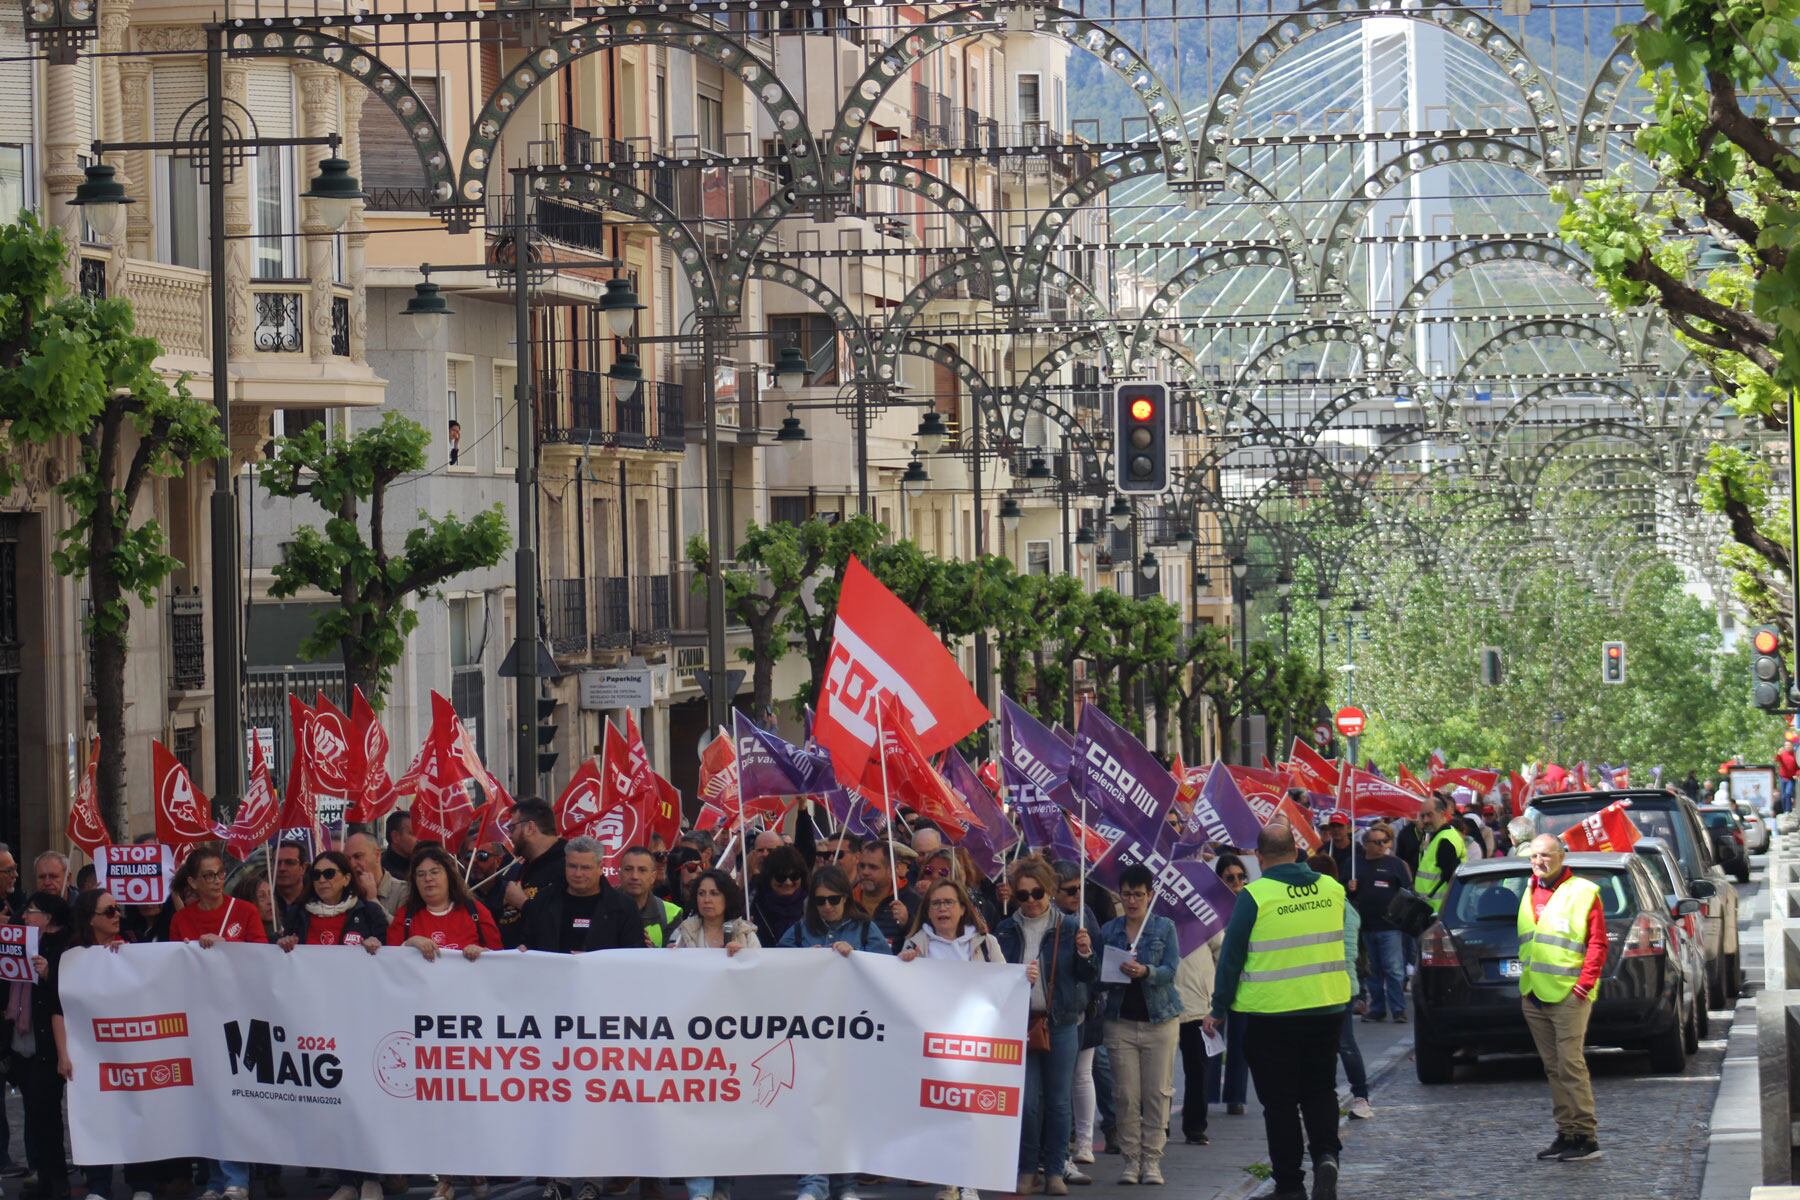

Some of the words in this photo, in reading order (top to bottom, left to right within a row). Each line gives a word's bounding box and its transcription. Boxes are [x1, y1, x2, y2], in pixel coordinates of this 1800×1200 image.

[1087, 766, 1125, 804] valencià
[1249, 797, 1275, 819] UG
[111, 847, 157, 862] STOP
[110, 864, 157, 876] RETALLADES
[111, 878, 159, 901] EOI
[1287, 882, 1318, 899] CCOO
[0, 928, 23, 942] OP
[0, 957, 29, 979] OI
[97, 1020, 157, 1038] CCOO
[414, 1015, 482, 1039] PER
[497, 1015, 542, 1039] LA
[554, 1015, 675, 1040] PLENA
[687, 1010, 885, 1042] OCUPACIÓ:
[297, 1036, 337, 1050] 2024
[928, 1037, 992, 1058] CCOO
[415, 1046, 541, 1070] MENYS
[552, 1046, 737, 1076] JORNADA,
[108, 1068, 147, 1087] UGT
[298, 1095, 342, 1105] #1MAIG2024
[415, 1077, 572, 1102] MILLORS
[585, 1078, 741, 1103] SALARIS
[929, 1085, 975, 1108] UGT
